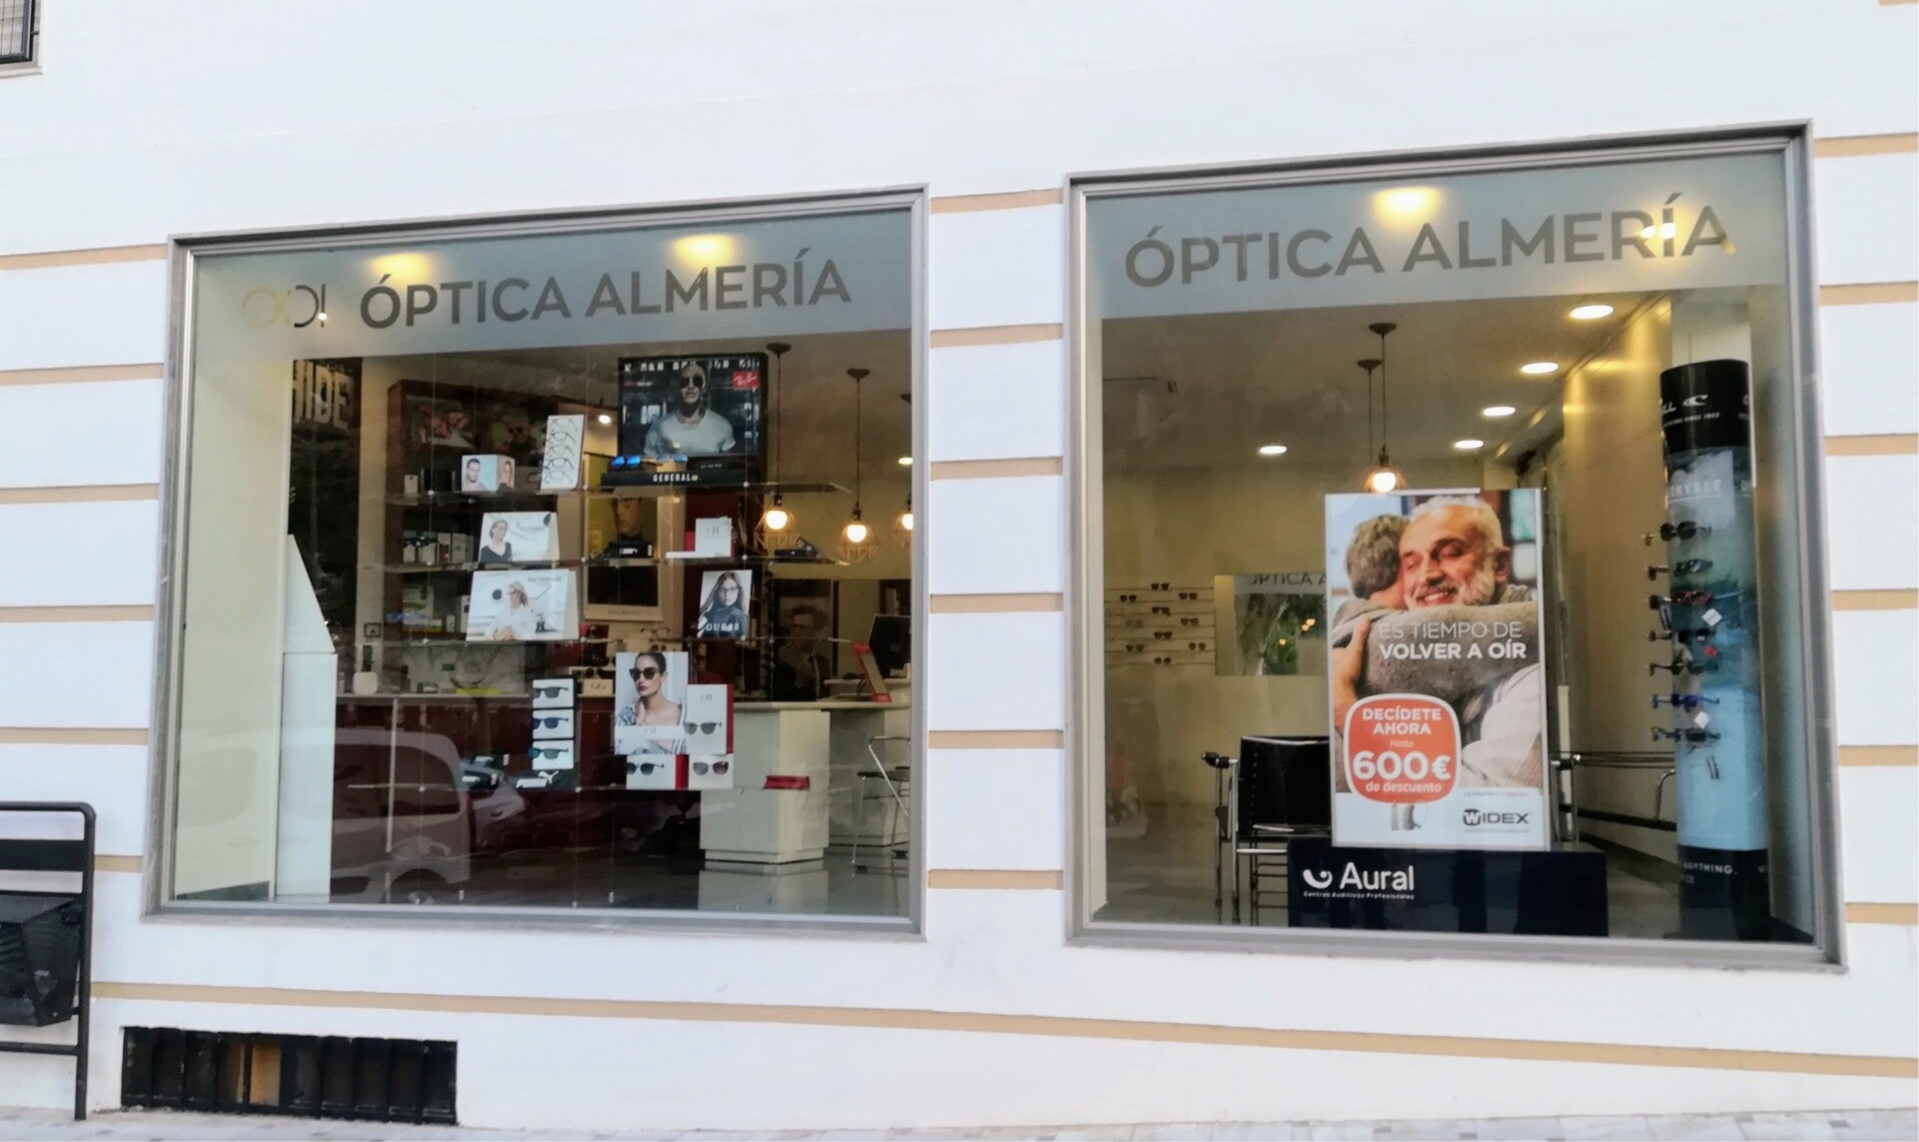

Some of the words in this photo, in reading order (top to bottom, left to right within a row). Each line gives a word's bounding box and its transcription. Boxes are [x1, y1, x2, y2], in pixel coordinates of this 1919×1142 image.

[1125, 225, 1385, 288] ÓPTICA
[1401, 192, 1733, 273] ALMERÍA
[360, 274, 571, 329] ÓPTICA
[585, 247, 851, 317] ALMERÍA
[652, 473, 691, 483] GENERAL
[1379, 622, 1404, 639] ES
[1411, 621, 1487, 639] TIEMPO
[1494, 620, 1523, 638] DE
[1379, 643, 1461, 660] VOLVER
[1467, 643, 1484, 659] A
[1488, 638, 1526, 660] OÍR
[1362, 704, 1442, 721] DECÍDETE
[1373, 722, 1431, 735] AHORA
[1353, 750, 1452, 781] 600€
[1366, 782, 1380, 792] de
[1383, 781, 1442, 793] descuento
[1463, 808, 1530, 826] WIDEX
[1339, 861, 1415, 891] Aural
